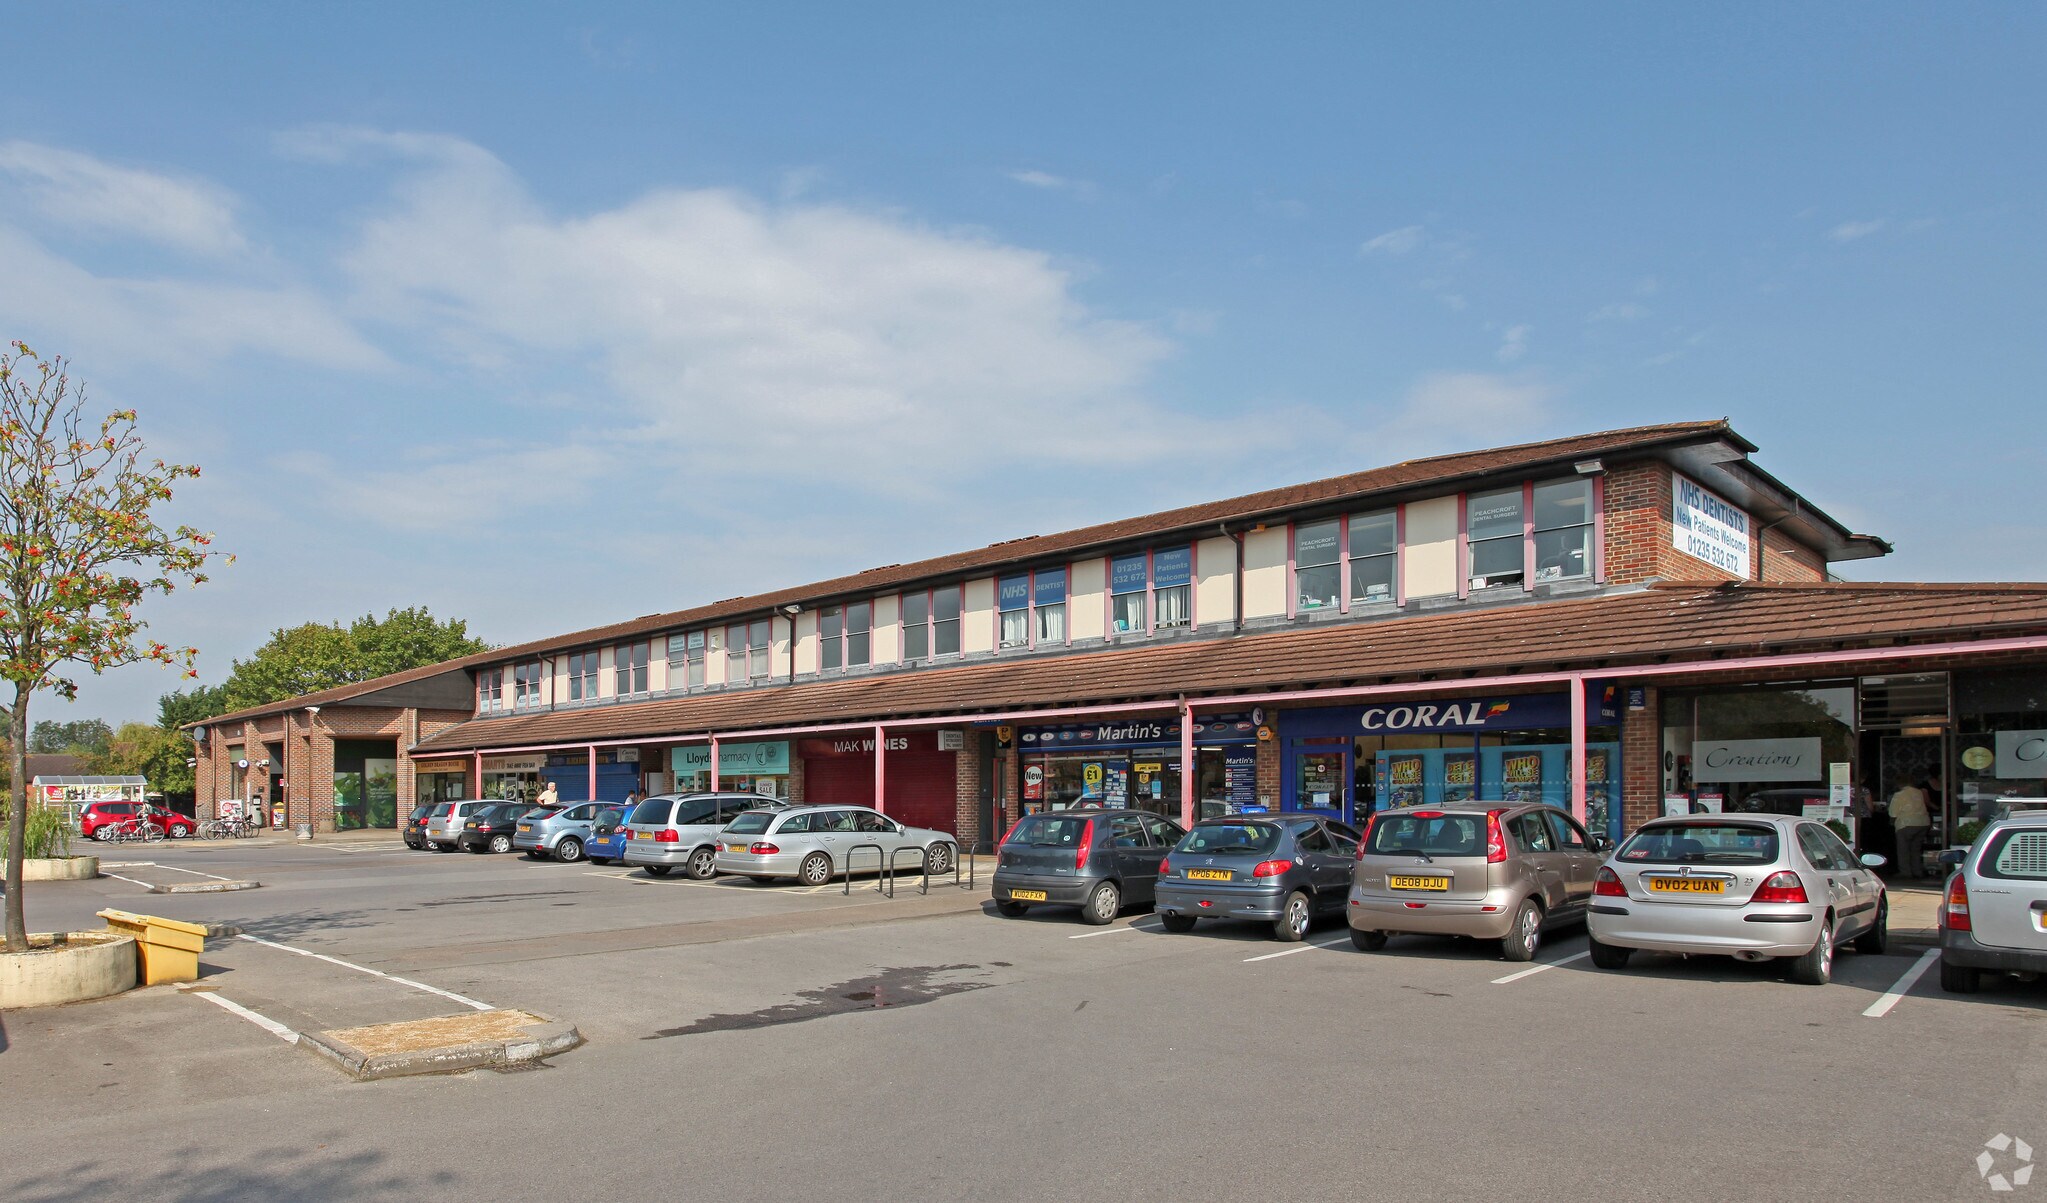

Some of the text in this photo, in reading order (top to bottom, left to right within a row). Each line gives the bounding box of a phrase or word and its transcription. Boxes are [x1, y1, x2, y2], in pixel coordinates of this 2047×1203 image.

[1474, 505, 1516, 516] PEACHCROFT
[1681, 479, 1744, 533] NHS DENTISTS
[1493, 511, 1518, 519] SURGERY
[1676, 506, 1747, 554] New Patients Welcome
[1164, 553, 1181, 561] New
[1688, 535, 1738, 572] 01235 532 672
[1117, 562, 1142, 573] 01235
[1157, 562, 1188, 572] Patients
[1114, 572, 1146, 584] 532 672
[1155, 572, 1190, 583] Welcome
[1002, 581, 1065, 600] NHS DENTIST
[1361, 702, 1487, 730] CORAL
[1602, 709, 1616, 717] CORAL
[1098, 723, 1161, 741] Martin's
[834, 740, 860, 753] MAK
[1225, 757, 1254, 765] Martin's
[1505, 755, 1540, 771] WHO
[1706, 747, 1803, 768] Creations
[1391, 758, 1422, 773] WHO
[1025, 771, 1043, 780] New
[1086, 770, 1098, 780] £1
[1191, 869, 1209, 878] KP06
[1395, 877, 1443, 887] OE08 DJU
[1655, 880, 1719, 891] OV02 UAN
